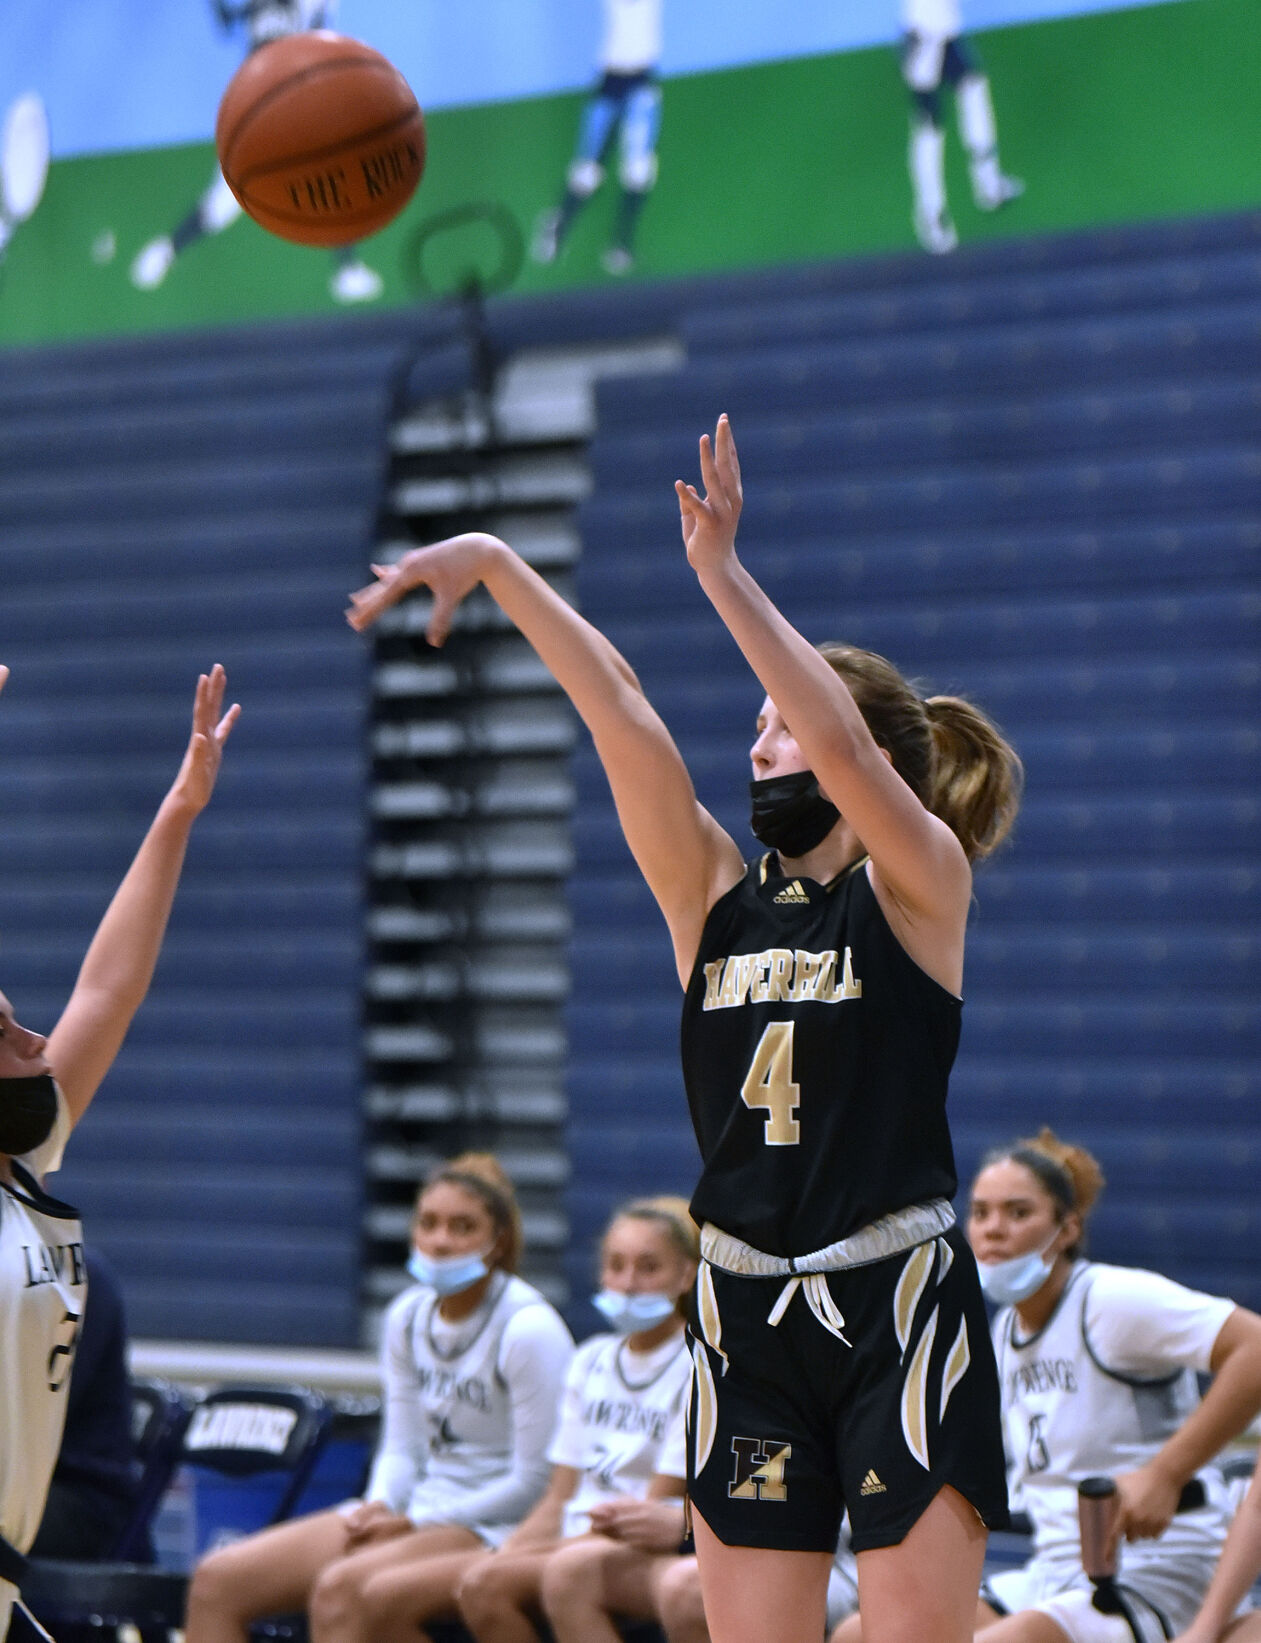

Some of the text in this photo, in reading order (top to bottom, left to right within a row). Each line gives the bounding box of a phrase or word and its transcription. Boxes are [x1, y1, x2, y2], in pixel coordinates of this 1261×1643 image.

[285, 166, 352, 211] THE
[773, 895, 811, 904] adidas
[740, 1020, 800, 1146] 4
[727, 1436, 792, 1502] H
